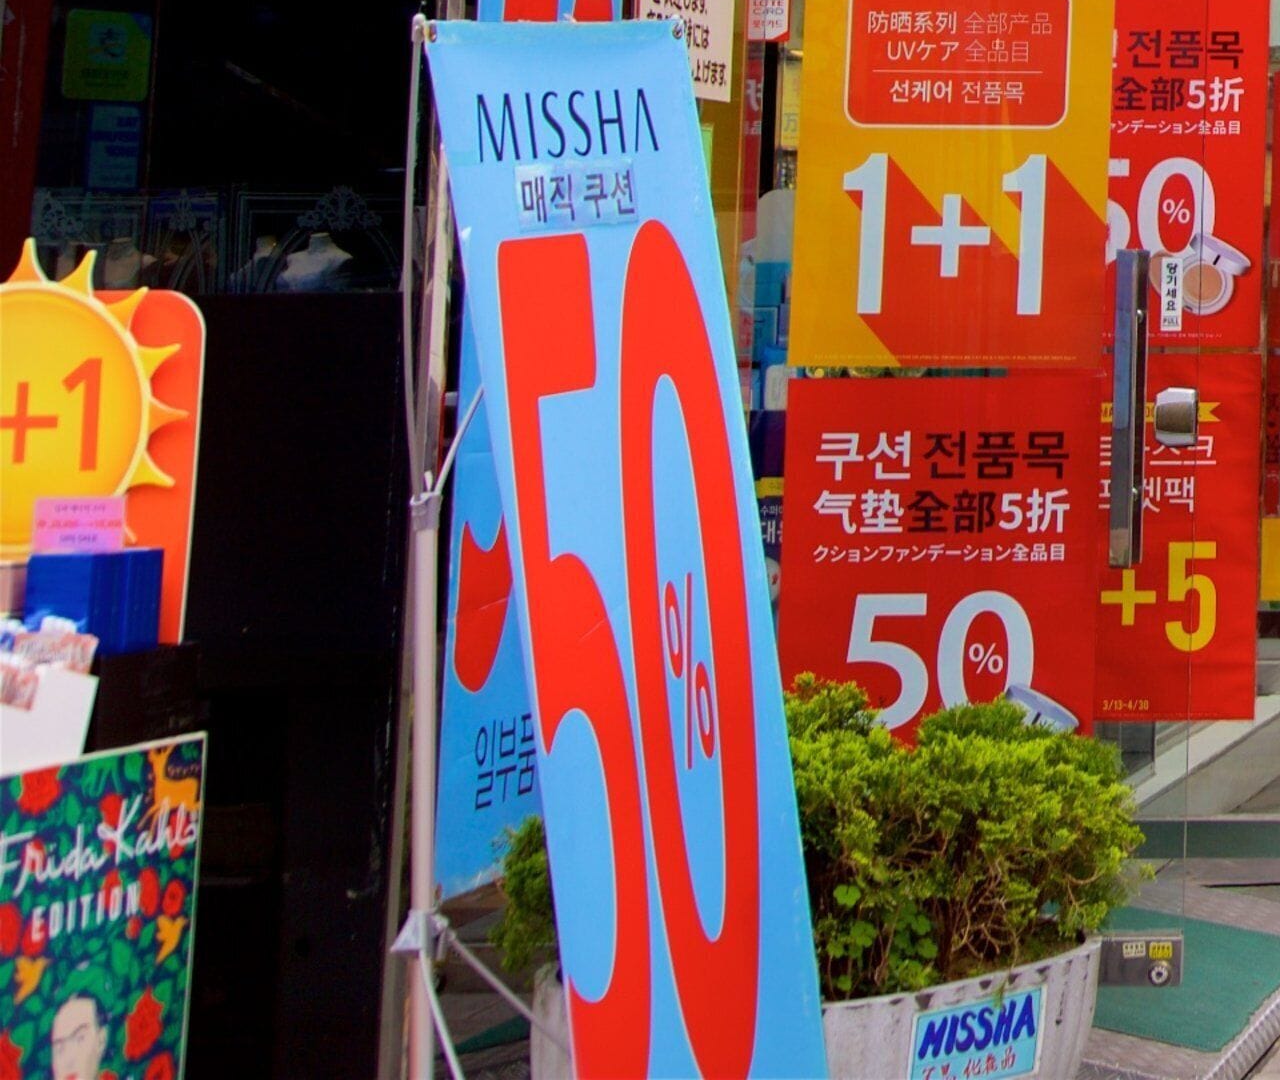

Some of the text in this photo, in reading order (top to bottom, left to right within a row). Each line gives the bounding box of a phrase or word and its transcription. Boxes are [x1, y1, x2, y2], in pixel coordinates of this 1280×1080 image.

[1126, 29, 1244, 70] 전품목
[888, 80, 1026, 105] 선케어 전품목
[474, 87, 661, 164] MISSHA
[519, 169, 638, 224] 매직 쿠션
[842, 152, 1049, 317] 1+1
[815, 430, 1070, 481] 쿠션 전품목
[30, 880, 141, 946] EDITION
[917, 993, 1037, 1062] MISSHA
